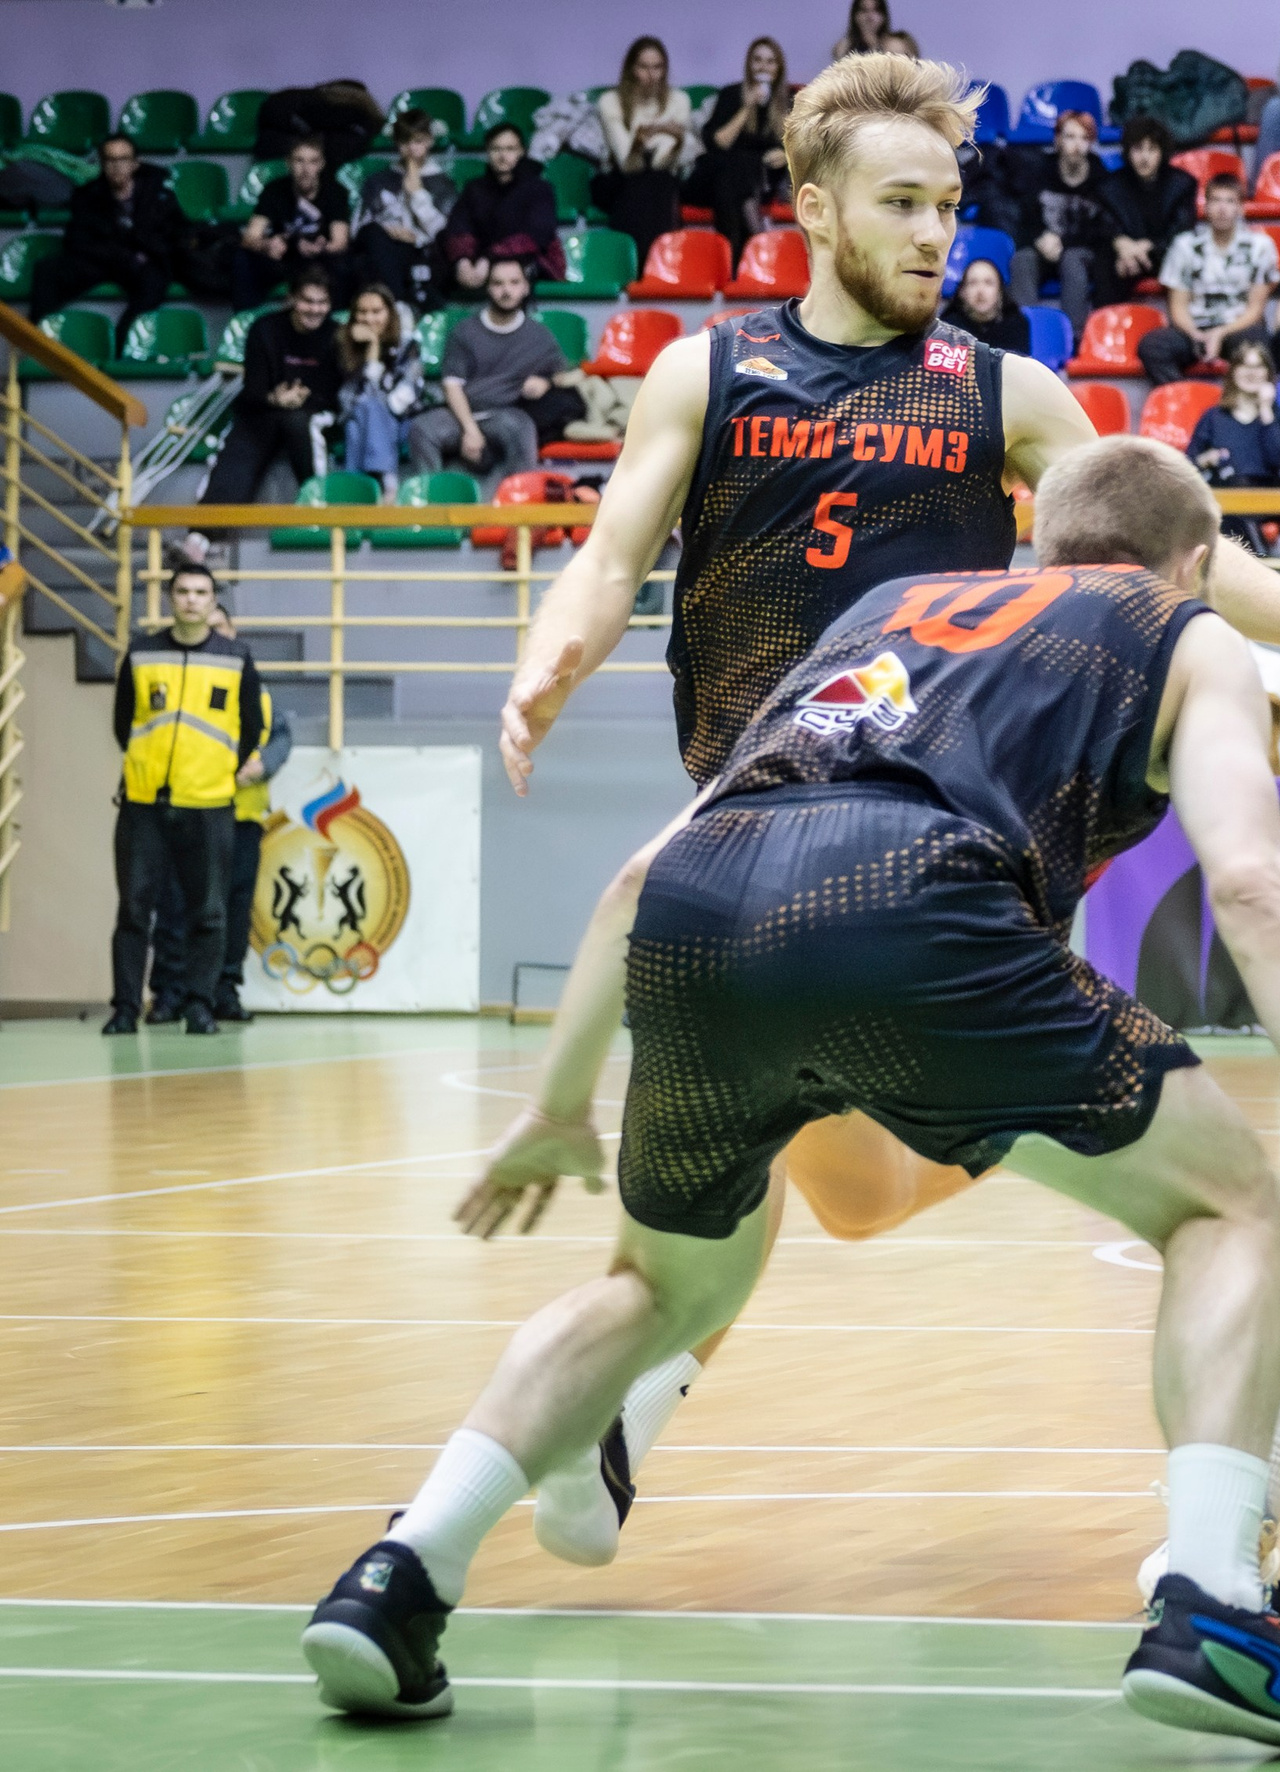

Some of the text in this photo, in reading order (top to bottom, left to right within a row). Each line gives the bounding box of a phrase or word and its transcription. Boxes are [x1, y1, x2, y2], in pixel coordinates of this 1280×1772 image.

[927, 352, 966, 374] BET
[928, 342, 968, 360] FON
[731, 415, 969, 473] ТЕМП-СУМЗ
[805, 491, 858, 569] 5
[881, 572, 1075, 654] 10
